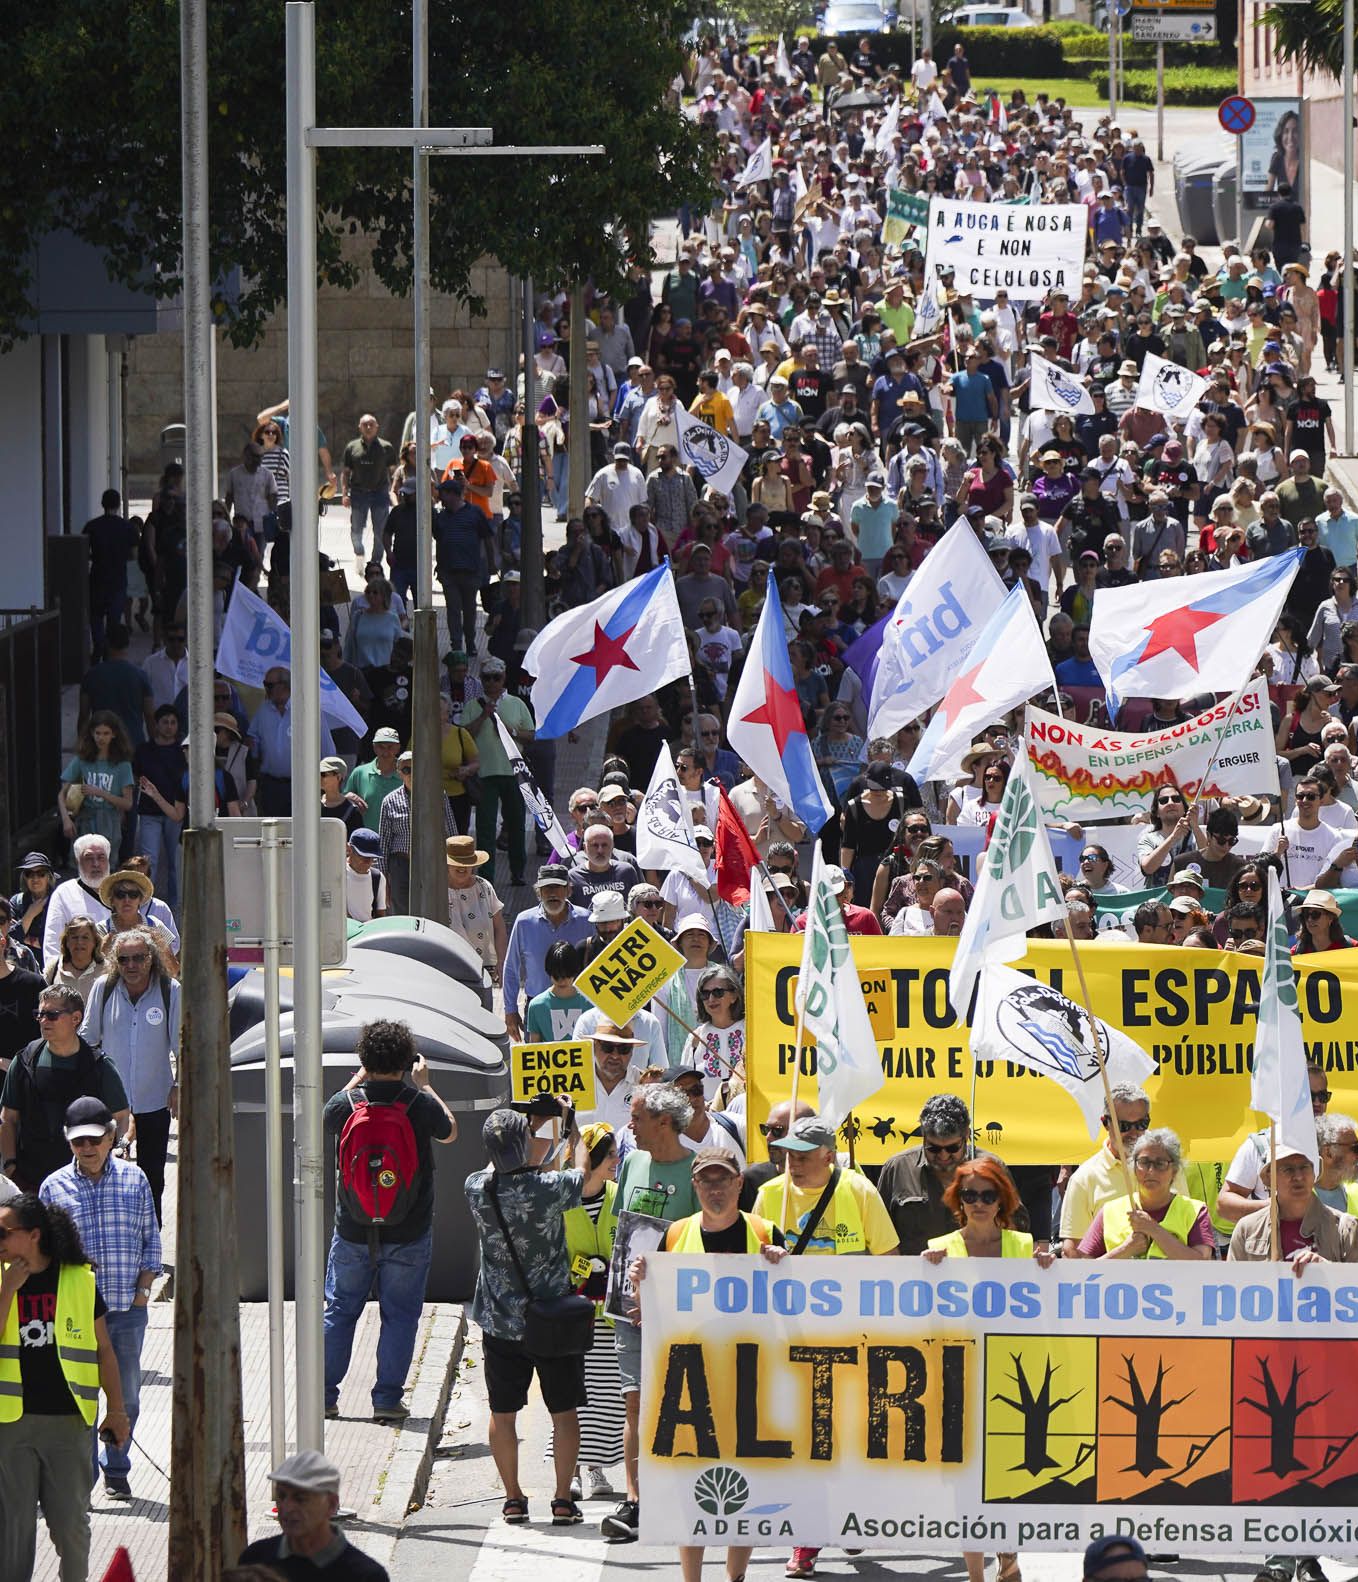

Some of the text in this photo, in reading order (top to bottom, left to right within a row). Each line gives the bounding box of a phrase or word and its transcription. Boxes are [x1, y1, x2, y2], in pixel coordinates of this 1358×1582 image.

[937, 210, 1072, 232] A AUGA É NOSA
[977, 239, 1031, 256] E NON
[970, 268, 1065, 287] CELULOSA
[1031, 693, 1261, 751] NON ÁS CELULOSAS!
[1089, 718, 1264, 768] EN DEFENSA DA TERRA
[1219, 751, 1260, 769] ERGUER
[589, 929, 650, 994] ALTRI
[609, 953, 657, 1001] NÃO
[628, 968, 669, 1011] GREENPEACE
[1121, 968, 1343, 1027] ESPAO
[522, 1048, 584, 1070] ENCE
[948, 1047, 963, 1078] E
[522, 1070, 586, 1095] FÓRA
[18, 1292, 58, 1324] LTR
[676, 1268, 843, 1318] Polos
[859, 1279, 1041, 1319] nosos
[1058, 1273, 1186, 1326] ríos,
[650, 1340, 966, 1464] ALTRI
[693, 1519, 795, 1537] ADEGA
[841, 1513, 1006, 1540] Asociación
[1017, 1520, 1080, 1546] para
[1090, 1521, 1106, 1540] a
[1116, 1516, 1233, 1542] Defensa
